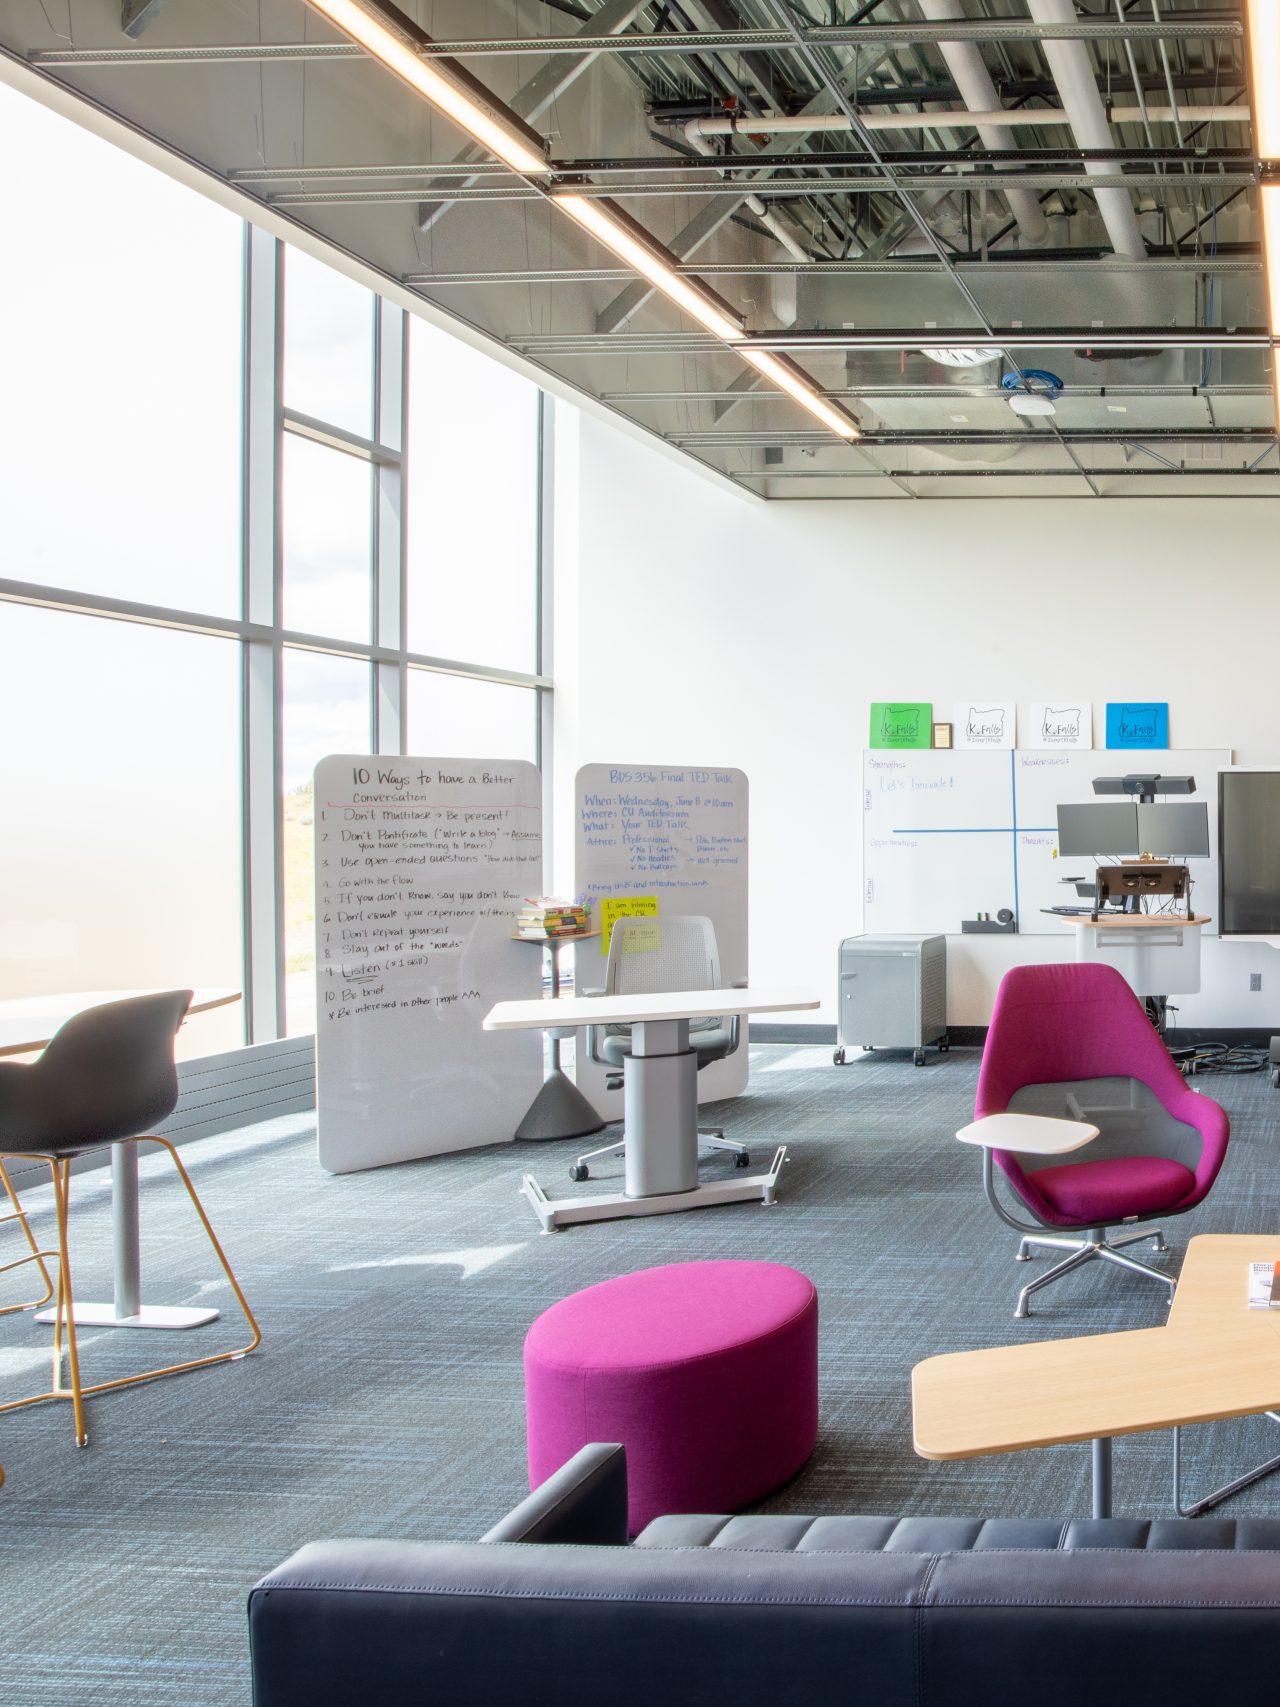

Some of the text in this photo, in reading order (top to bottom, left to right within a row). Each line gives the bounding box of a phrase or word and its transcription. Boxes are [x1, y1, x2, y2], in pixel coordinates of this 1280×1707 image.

[897, 723, 916, 735] Falls
[981, 723, 1001, 735] Falls
[1057, 724, 1077, 735] Falls
[1134, 724, 1154, 735] Falls
[352, 767, 516, 791] 10 Ways to have a Better
[610, 769, 633, 785] BUS
[635, 770, 658, 784] 356
[660, 771, 685, 783] Final
[690, 771, 710, 784] TED
[585, 793, 617, 808] When:
[618, 793, 674, 809] Wednesday,
[343, 808, 376, 821] Don't
[446, 811, 461, 822] Be
[581, 809, 618, 820] Where:
[621, 806, 636, 818] CU
[583, 821, 616, 833] What:
[621, 818, 643, 834] Your
[647, 819, 664, 830] TED
[340, 830, 372, 842] Don't
[377, 829, 428, 842] Pontificate
[358, 842, 375, 855] you
[378, 841, 399, 850] have
[402, 841, 449, 854] something
[340, 857, 359, 869] Use
[428, 853, 478, 866] questions
[354, 876, 373, 888] with
[377, 876, 390, 886] the
[392, 874, 415, 886] flow
[337, 890, 498, 906] If you don't say you don't
[337, 911, 366, 923] Don't
[427, 908, 476, 920] experience
[341, 926, 451, 941] Don't yourself
[341, 944, 370, 958] Stay
[374, 943, 390, 953] out
[394, 942, 404, 951] of
[411, 941, 424, 951] the
[341, 964, 381, 979] Listen
[341, 985, 386, 1001] Be brief
[337, 1007, 354, 1020] Be
[355, 1000, 397, 1014] interested
[411, 997, 432, 1007] other
